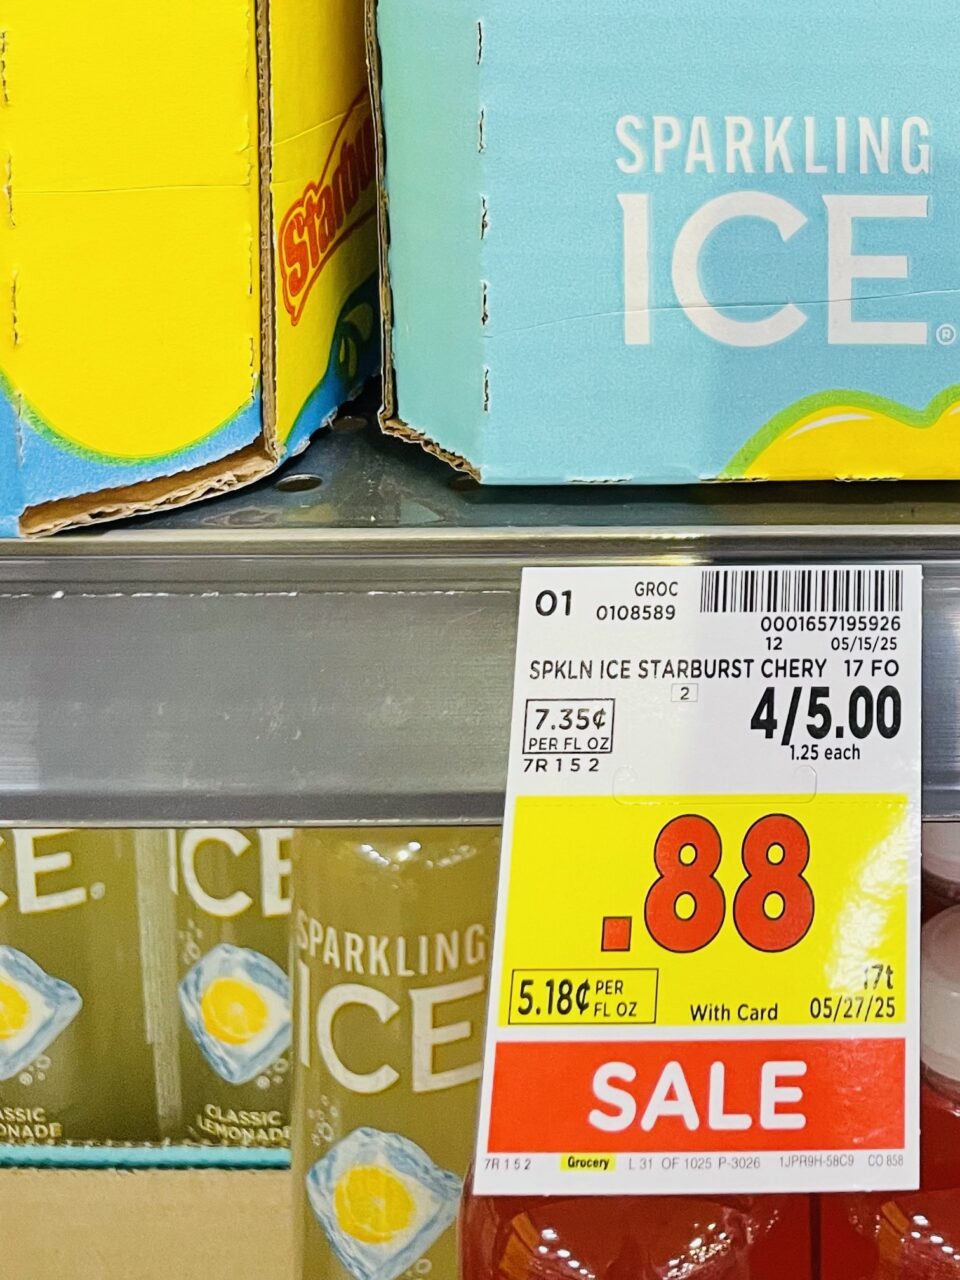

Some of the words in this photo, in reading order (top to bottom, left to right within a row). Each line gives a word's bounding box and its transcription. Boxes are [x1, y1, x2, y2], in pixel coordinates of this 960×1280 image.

[615, 114, 931, 174] SPARKLING
[617, 190, 929, 347] ICE
[634, 581, 679, 597] GROC
[596, 605, 676, 621] 0108589
[760, 616, 901, 632] 0001657195926
[766, 637, 783, 651] 12
[830, 636, 898, 653] 05/15/25
[529, 660, 593, 680] SPKLN
[600, 660, 631, 679] ICE
[637, 659, 754, 679] STARBURST
[760, 659, 827, 678] CHERY
[844, 660, 863, 677] 17
[871, 659, 900, 677] FO
[680, 687, 690, 701] 2
[535, 708, 607, 731] 7.35¢
[750, 685, 902, 746] 4/5.00
[528, 737, 557, 751] PER
[564, 737, 582, 751] FL
[586, 737, 609, 751] OZ
[789, 745, 819, 761] 1.25
[824, 745, 861, 761] each
[523, 758, 548, 773] 7R
[588, 758, 600, 772] 2
[298, 908, 486, 977] SPARKLING
[595, 980, 623, 995] PER
[517, 978, 591, 1018] 5.18¢
[594, 1002, 611, 1017] FL
[616, 1002, 638, 1017] OZ
[690, 1004, 731, 1021] With
[737, 1004, 778, 1021] Card
[809, 996, 896, 1022] 05/27/25
[299, 962, 486, 1094] ICE
[588, 1060, 808, 1131] SALE
[205, 1103, 282, 1126] CLASSIC
[567, 1156, 610, 1171] Grocery
[661, 1157, 679, 1169] OF
[684, 1157, 713, 1169] 1025
[718, 1157, 761, 1169] P-3026
[868, 1154, 884, 1166] CO
[887, 1154, 905, 1166] 858
